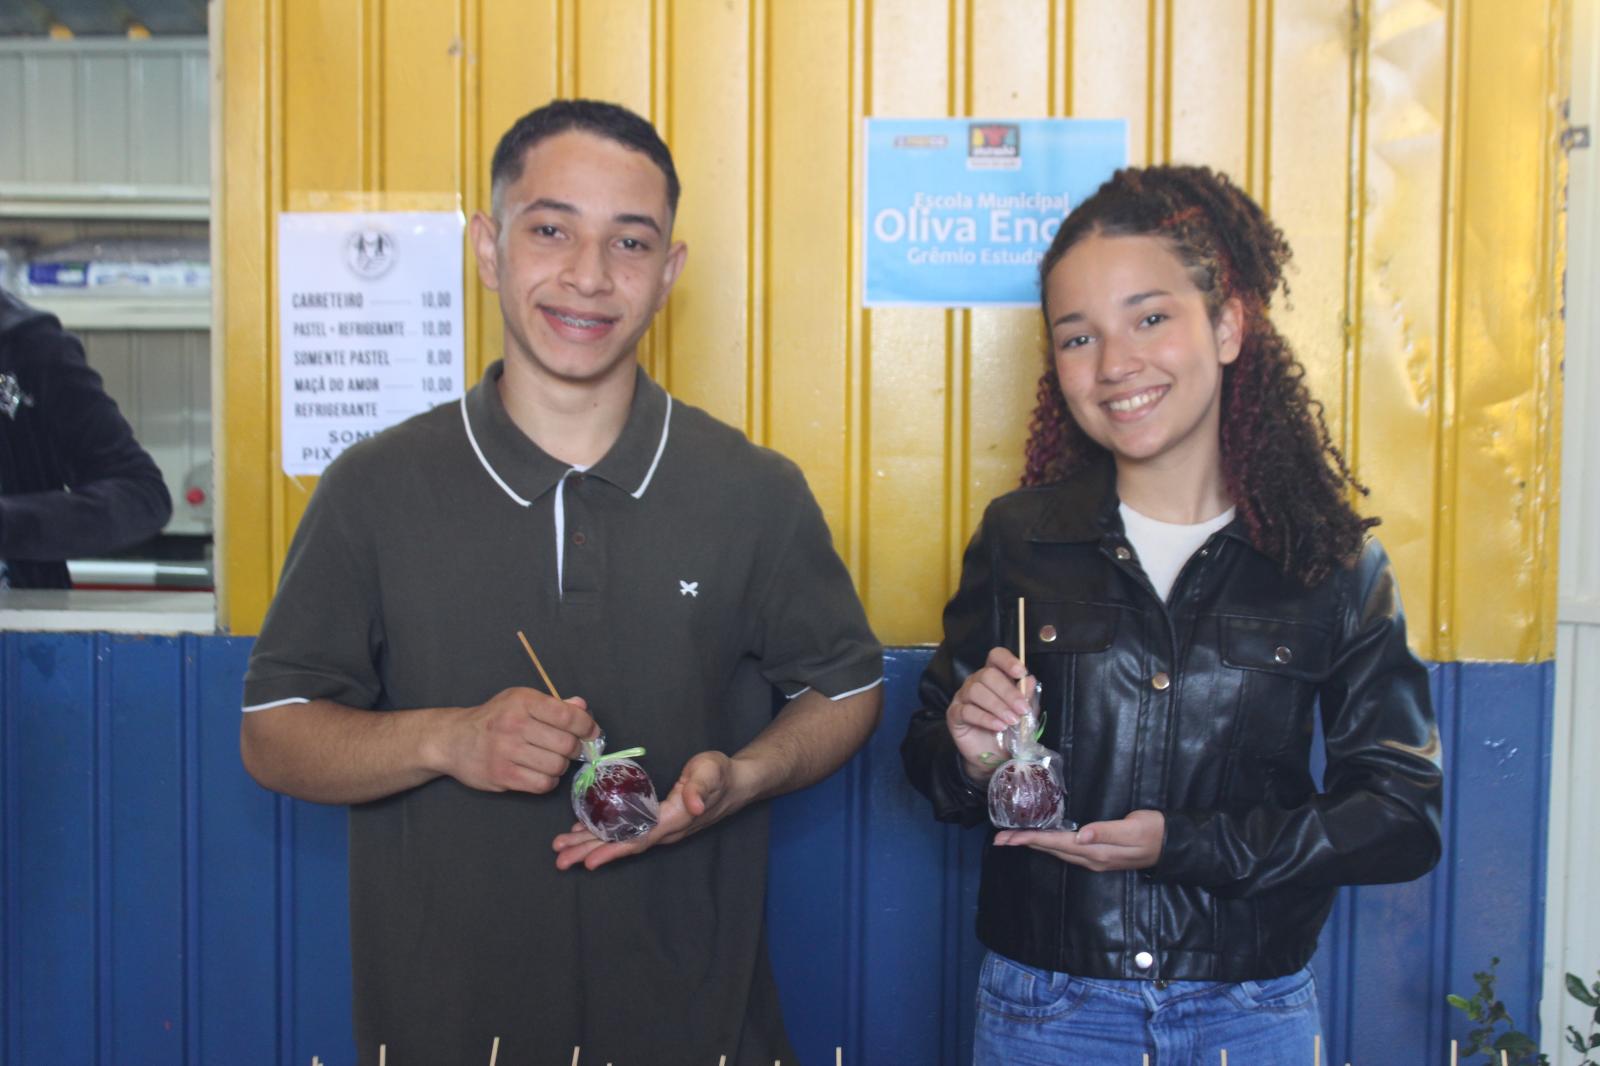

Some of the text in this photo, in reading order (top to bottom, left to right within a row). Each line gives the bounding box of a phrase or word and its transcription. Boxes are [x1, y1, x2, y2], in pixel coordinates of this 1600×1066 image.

[914, 192, 1069, 213] Escola Municipal
[874, 207, 1069, 243] Oliva Enc
[907, 246, 1043, 264] Grêmio Estuda
[292, 292, 364, 308] CARRETEIRO
[293, 322, 327, 336] PASTEL
[338, 321, 405, 336] REFRIGERANTE
[294, 350, 346, 366] SOMENTE
[349, 350, 390, 366] PASTEL
[294, 376, 326, 394] MAÇÃ
[329, 379, 344, 391] DO
[349, 378, 380, 391] AMOR
[294, 402, 378, 417] REFRIGERANTE
[302, 447, 332, 460] PIX
